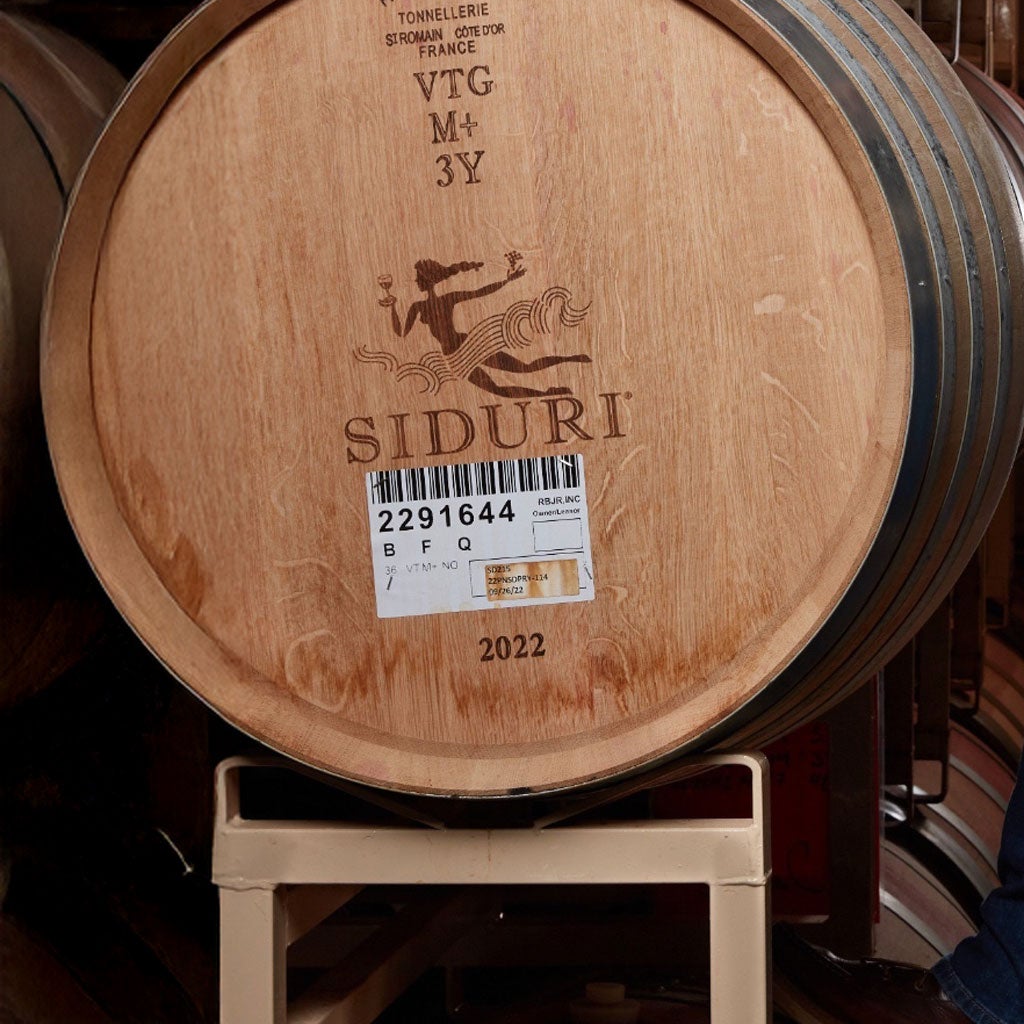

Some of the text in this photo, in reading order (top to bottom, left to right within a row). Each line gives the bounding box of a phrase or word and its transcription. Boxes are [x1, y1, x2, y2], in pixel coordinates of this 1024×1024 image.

[398, 2, 489, 25] TONNELLERIE
[399, 28, 443, 45] ROMAIN
[455, 25, 481, 39] CÔTE
[482, 23, 506, 36] D'OR
[419, 40, 477, 58] FRANCE
[413, 64, 494, 102] VTG
[428, 110, 478, 144] M+
[436, 150, 485, 187] 3Y
[344, 392, 627, 464] SIDURI
[378, 500, 516, 533] 2291644
[383, 537, 472, 557] B F Q
[479, 632, 546, 662] 2022
